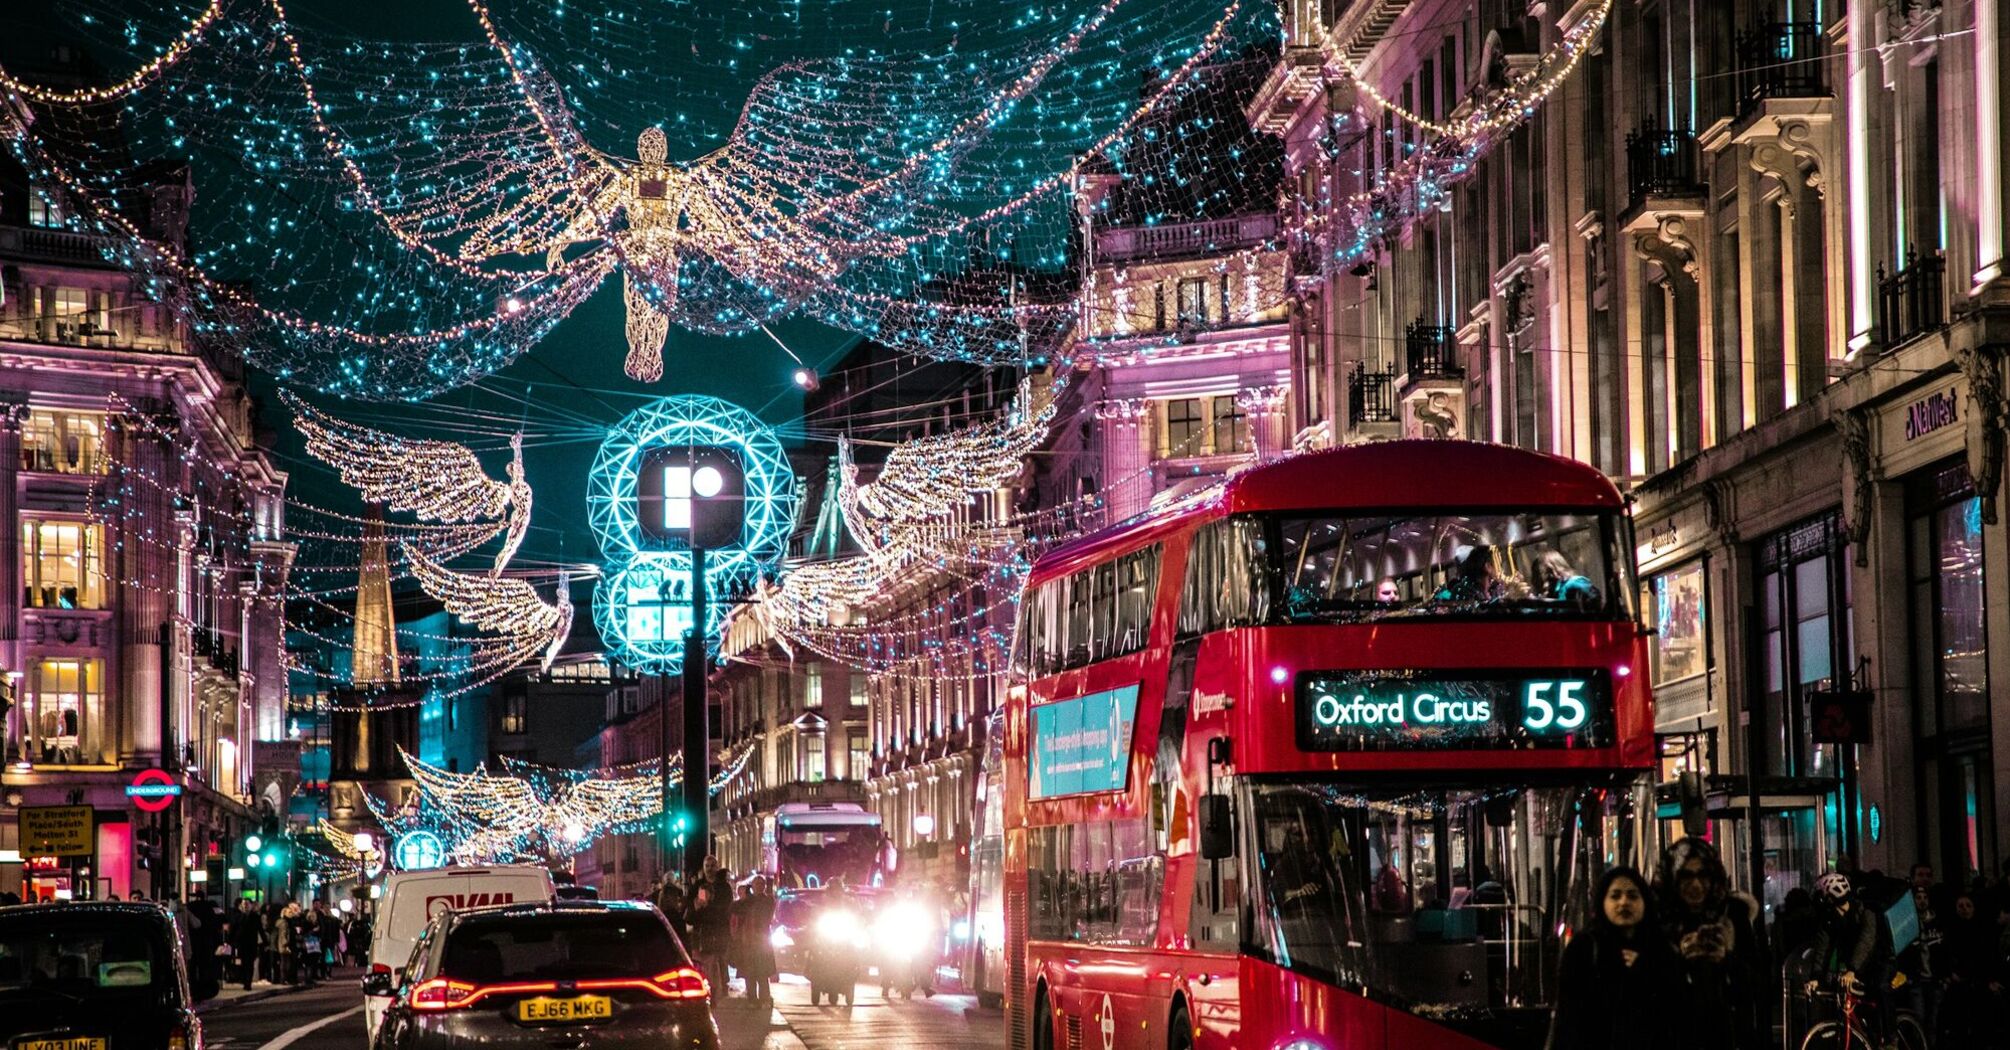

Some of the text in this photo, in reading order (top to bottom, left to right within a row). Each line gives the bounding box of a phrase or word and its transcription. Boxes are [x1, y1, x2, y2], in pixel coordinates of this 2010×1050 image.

[1912, 387, 1958, 437] NatWest
[1316, 693, 1491, 724] Oxford Circus
[1525, 681, 1586, 729] 55
[127, 786, 178, 794] UNDERGROUND
[44, 809, 86, 818] Stratford
[29, 820, 84, 829] Place/South
[527, 1001, 604, 1017] EJ66 MKG
